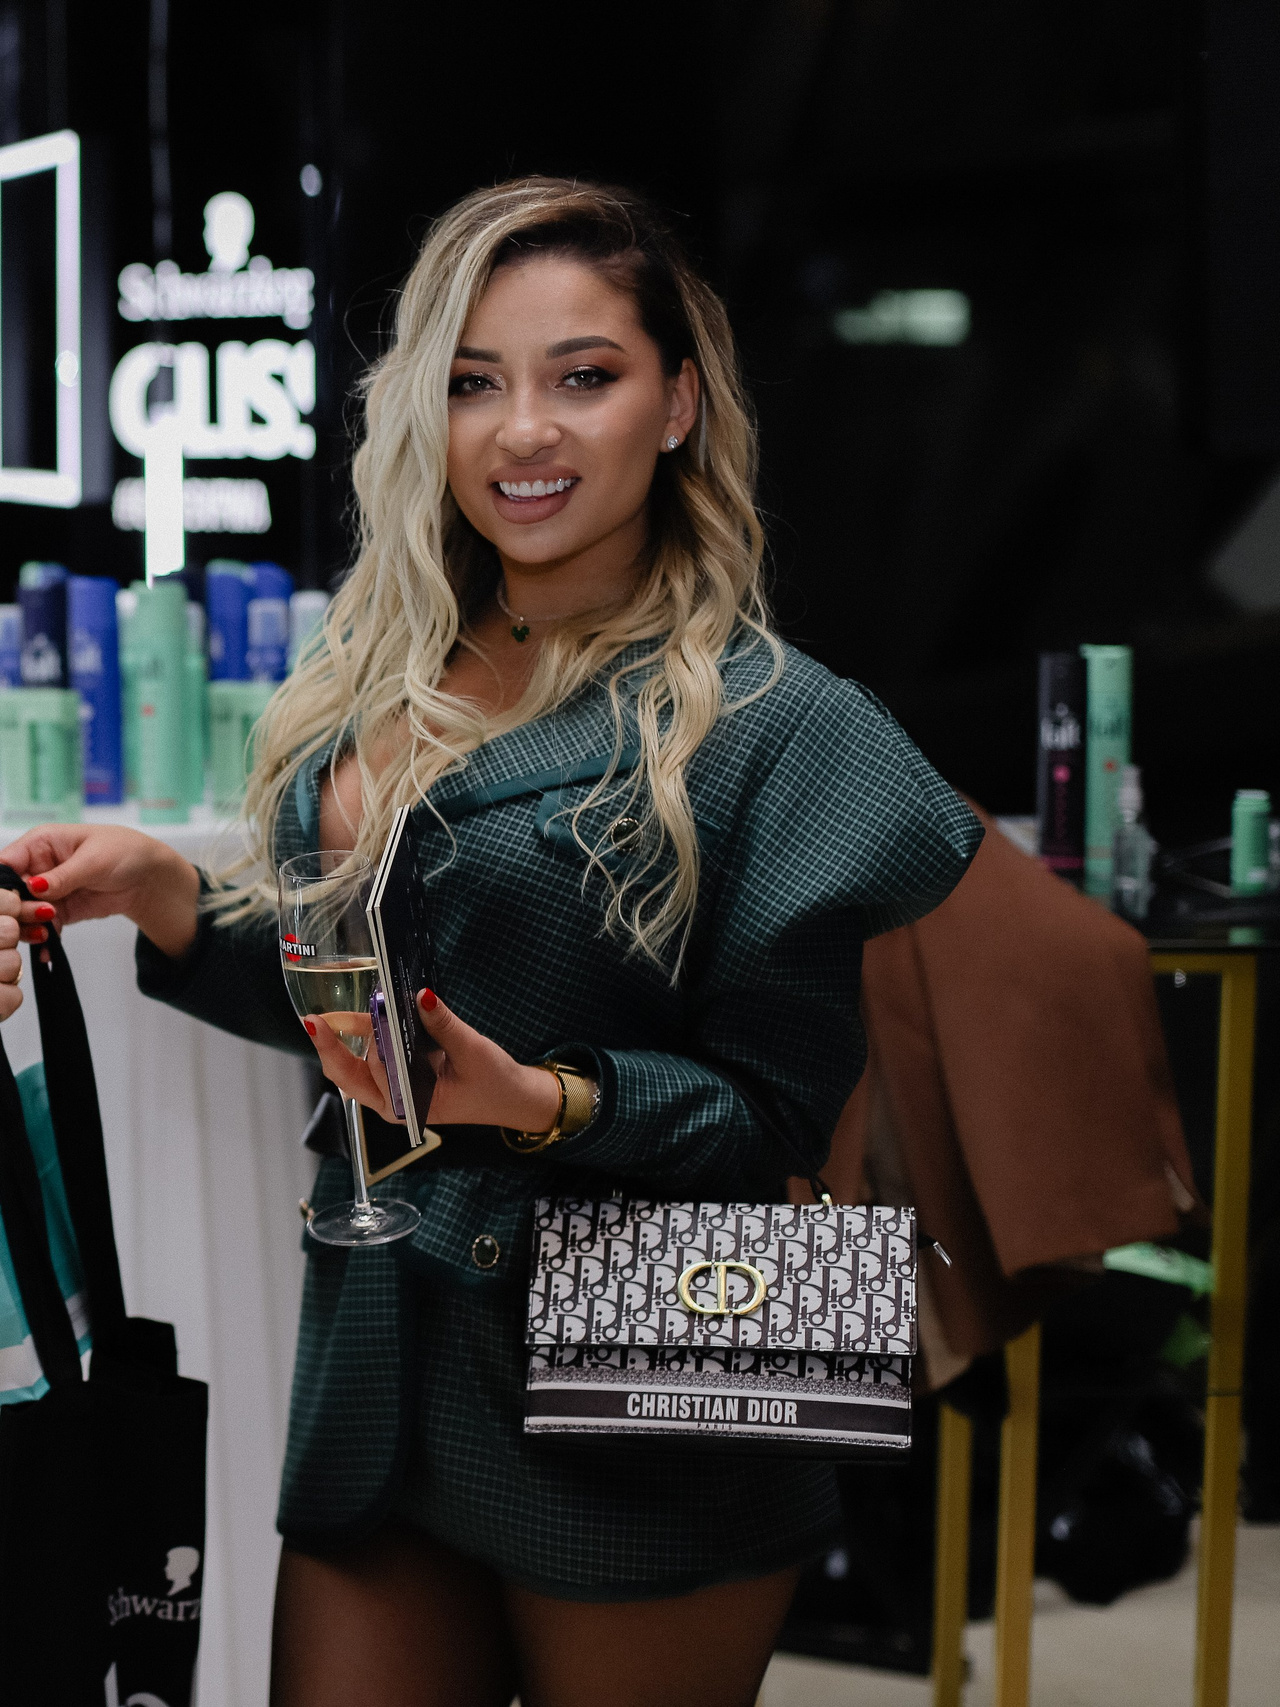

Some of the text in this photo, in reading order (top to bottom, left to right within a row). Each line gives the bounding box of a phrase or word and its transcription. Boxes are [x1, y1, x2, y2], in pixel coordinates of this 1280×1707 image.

[627, 1393, 798, 1424] CHRISTIAN DIOR
[697, 1422, 733, 1430] PARIS
